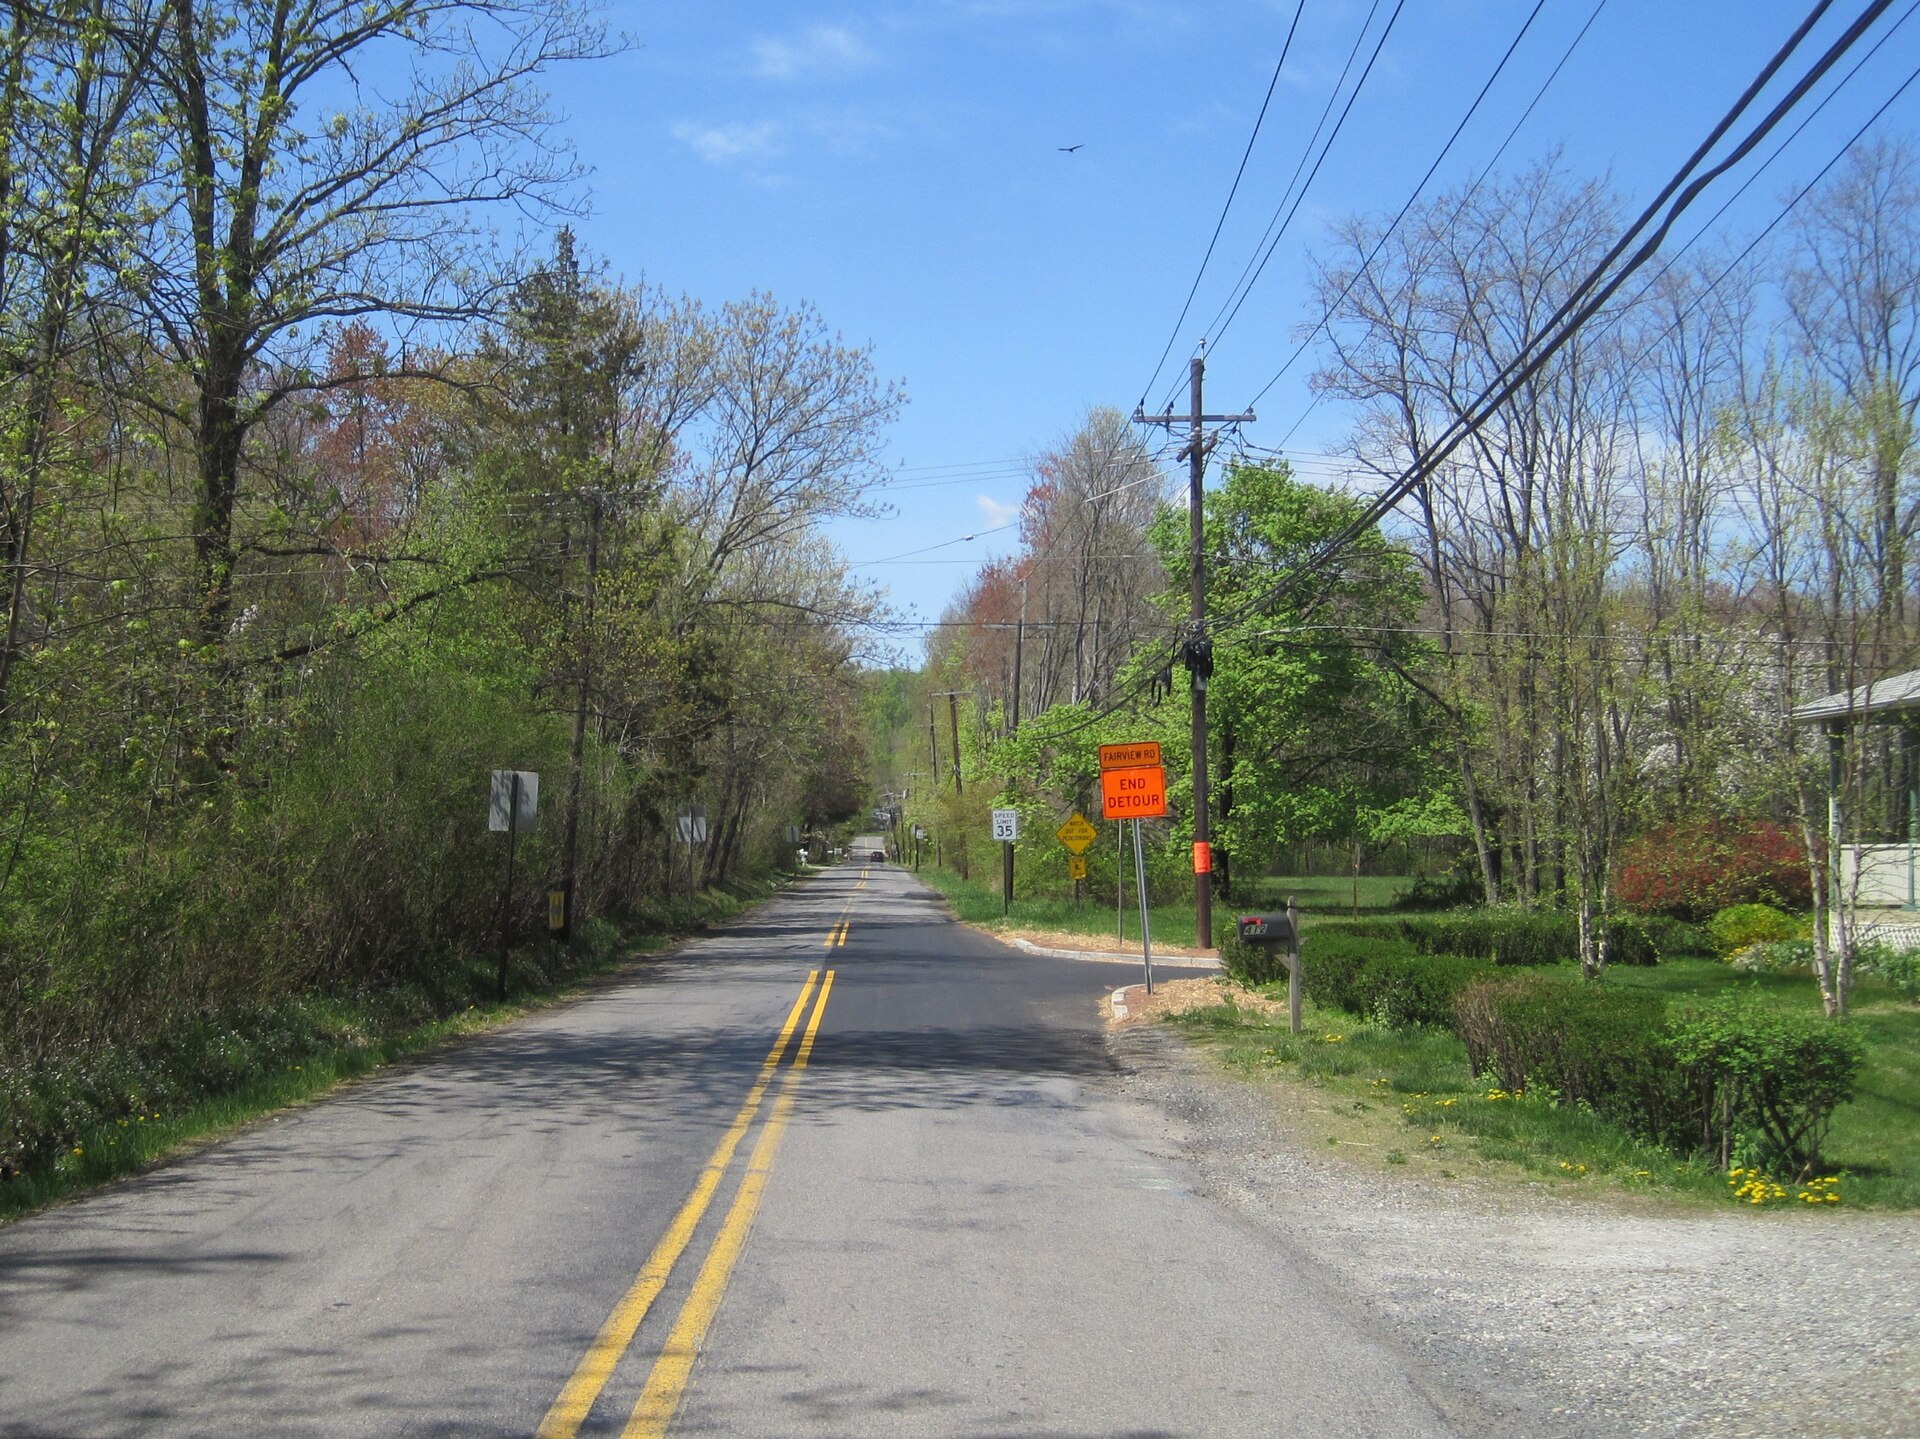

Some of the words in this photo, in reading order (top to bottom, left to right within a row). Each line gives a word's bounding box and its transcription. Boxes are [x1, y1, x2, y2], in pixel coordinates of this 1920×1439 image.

[1103, 750, 1142, 762] FAIRVIEW
[1143, 749, 1156, 759] RD
[1120, 778, 1146, 790] END
[1107, 794, 1160, 809] DETOUR
[996, 825, 1013, 837] 35
